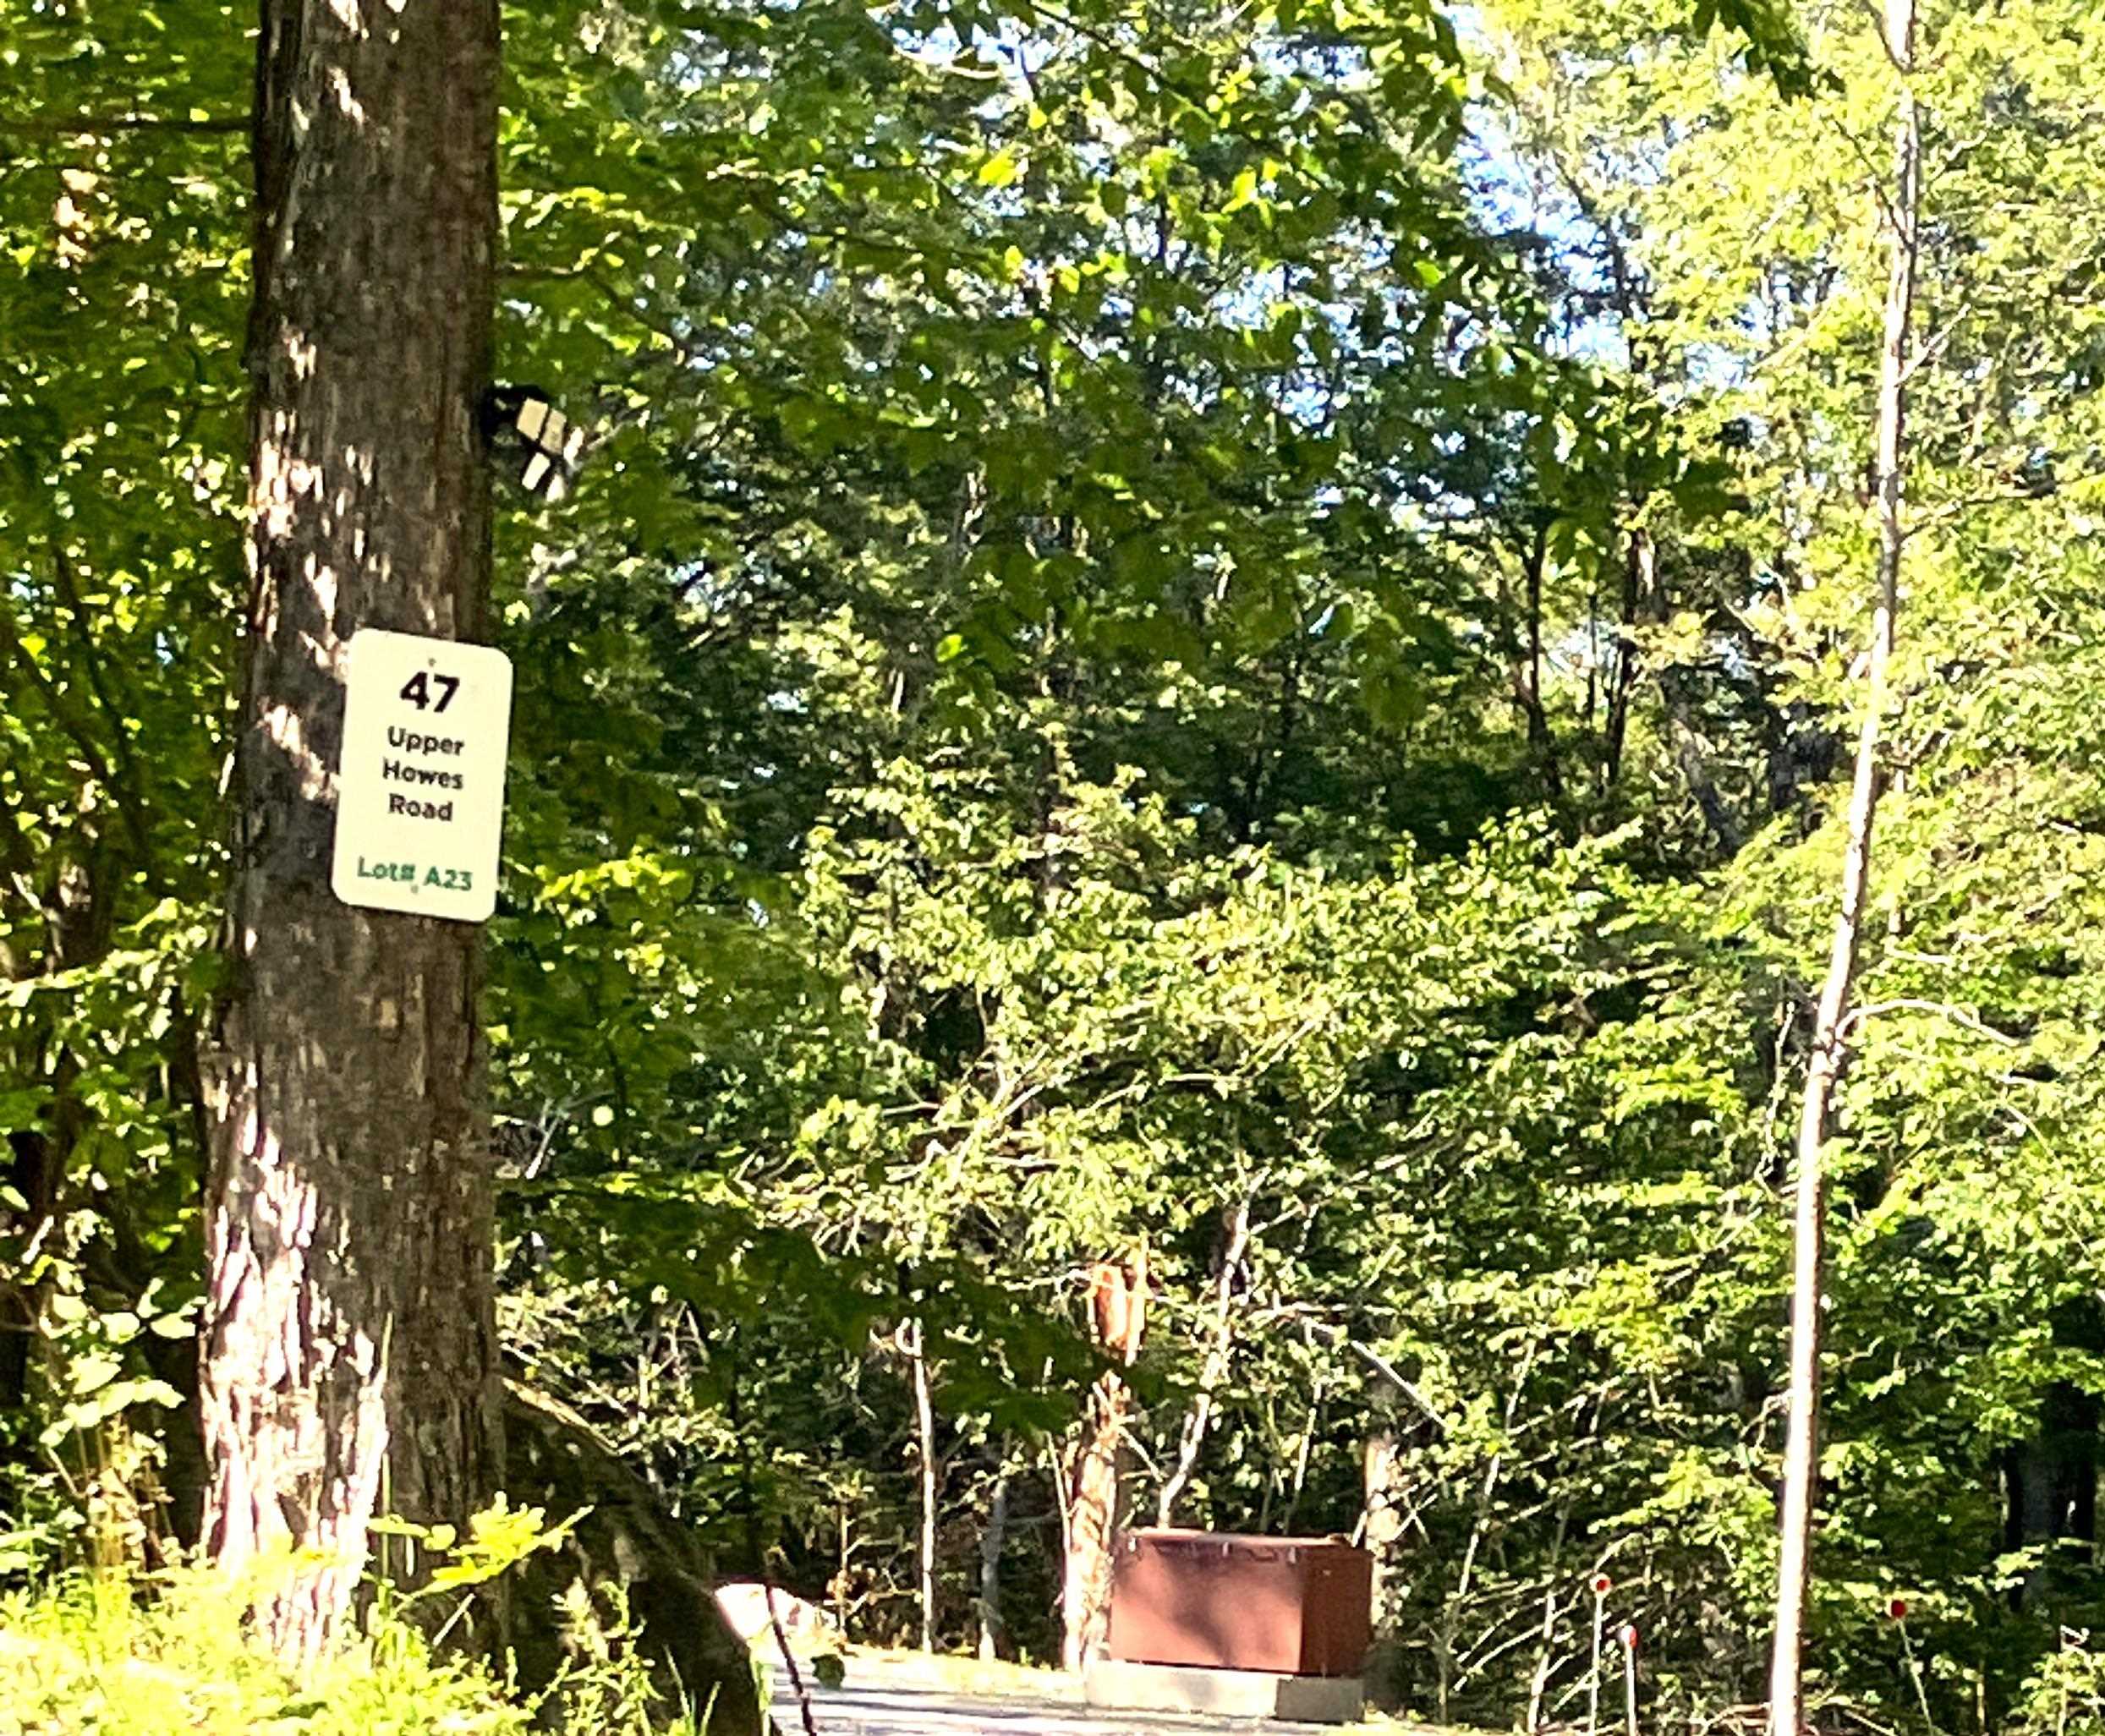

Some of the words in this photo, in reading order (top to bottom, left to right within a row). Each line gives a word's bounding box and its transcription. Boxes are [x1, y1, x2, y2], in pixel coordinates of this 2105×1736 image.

[399, 671, 460, 713] 47
[387, 726, 464, 756] Upper
[382, 757, 463, 790] Howes
[388, 793, 453, 822] Road
[357, 856, 415, 882] Lot#
[423, 866, 474, 891] A23
